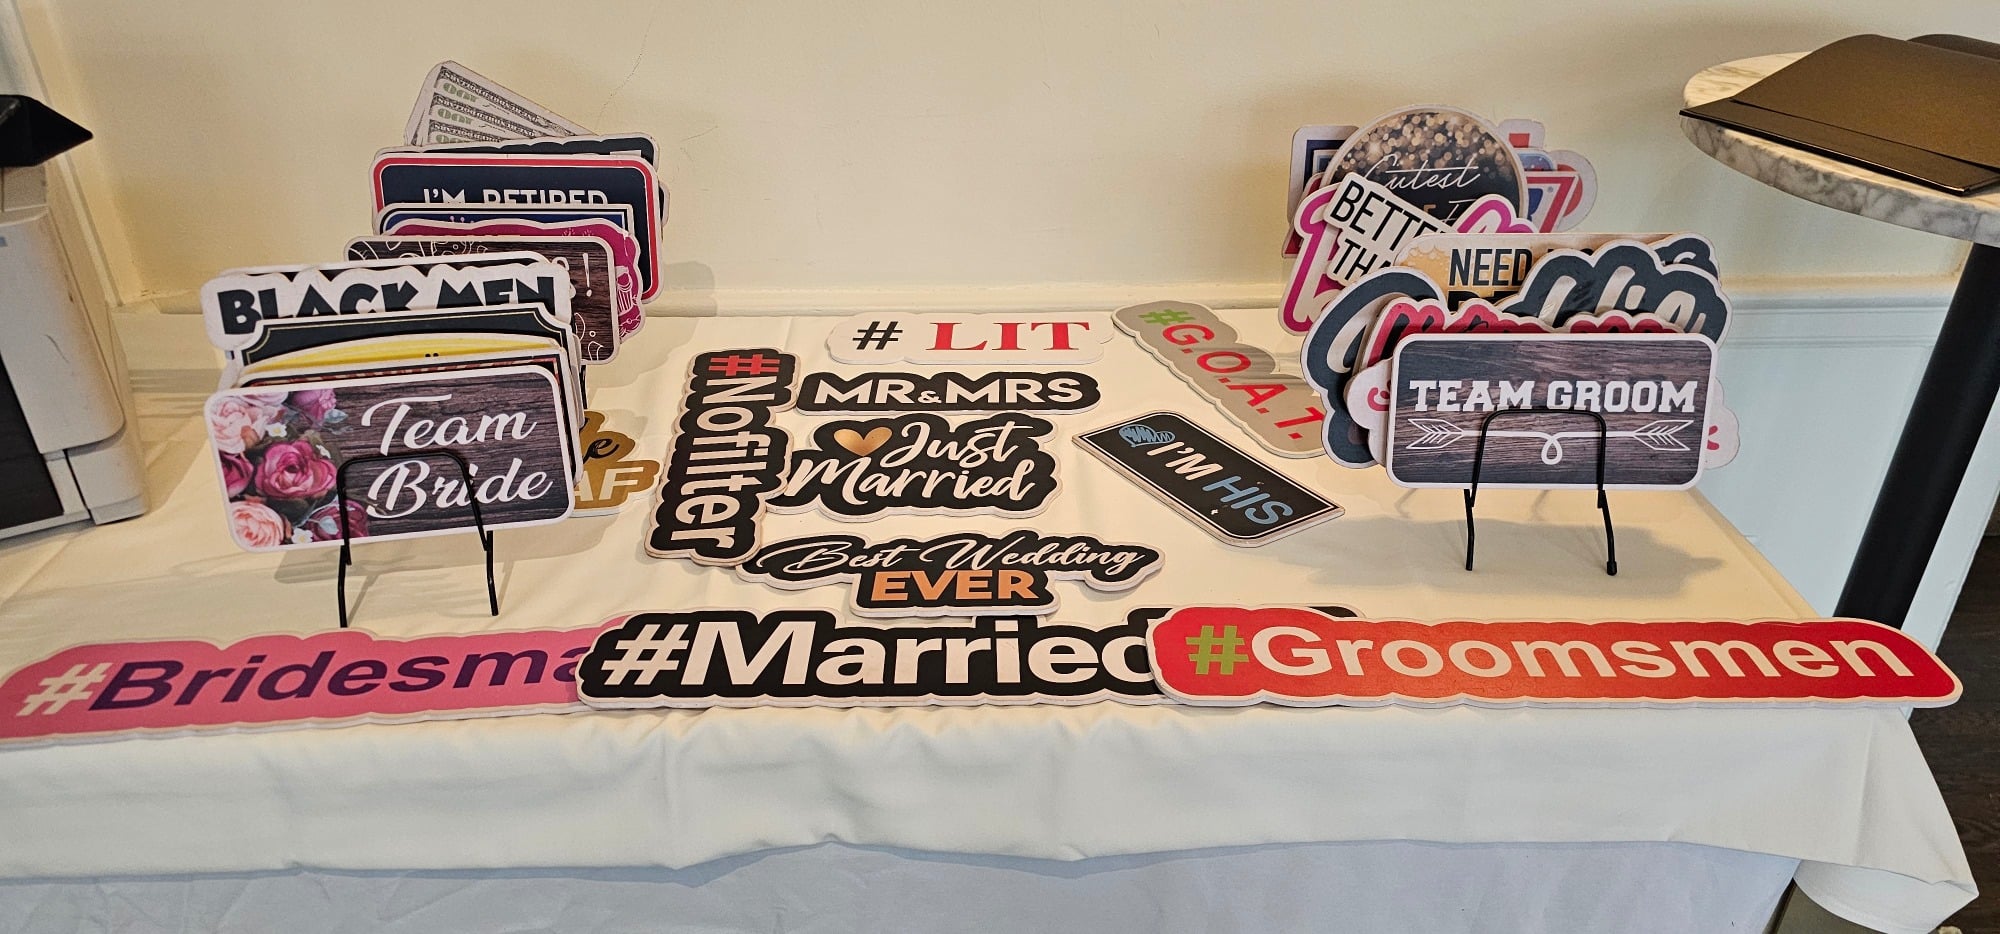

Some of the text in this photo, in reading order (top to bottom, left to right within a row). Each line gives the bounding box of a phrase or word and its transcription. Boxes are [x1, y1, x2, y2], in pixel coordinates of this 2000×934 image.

[442, 82, 477, 103] 100
[443, 71, 483, 95] DOLLARS
[437, 108, 472, 125] 100
[438, 97, 477, 116] DOLLARS
[1361, 152, 1481, 191] Cutest
[1329, 179, 1446, 252] BETT
[1448, 248, 1532, 287] NEED
[217, 280, 419, 335] BLACK
[436, 276, 556, 317] MEN
[925, 321, 1091, 351] LIT
[813, 377, 1084, 405] MR&MRS
[1138, 308, 1326, 440] #G.O.A.T.
[1408, 380, 1536, 413] TEAM
[1545, 380, 1699, 414] GROOM
[361, 392, 539, 457] Team
[880, 420, 1034, 470] Just
[670, 353, 781, 549] #Nofilter
[366, 457, 554, 519] Bride
[784, 456, 1036, 506] Married
[1146, 441, 1295, 526] I'M HIS
[756, 536, 1146, 575] Best Wedding
[870, 569, 1040, 602] EVER
[1184, 623, 1915, 679] #Groomsmen
[15, 646, 592, 717] #Bridesma
